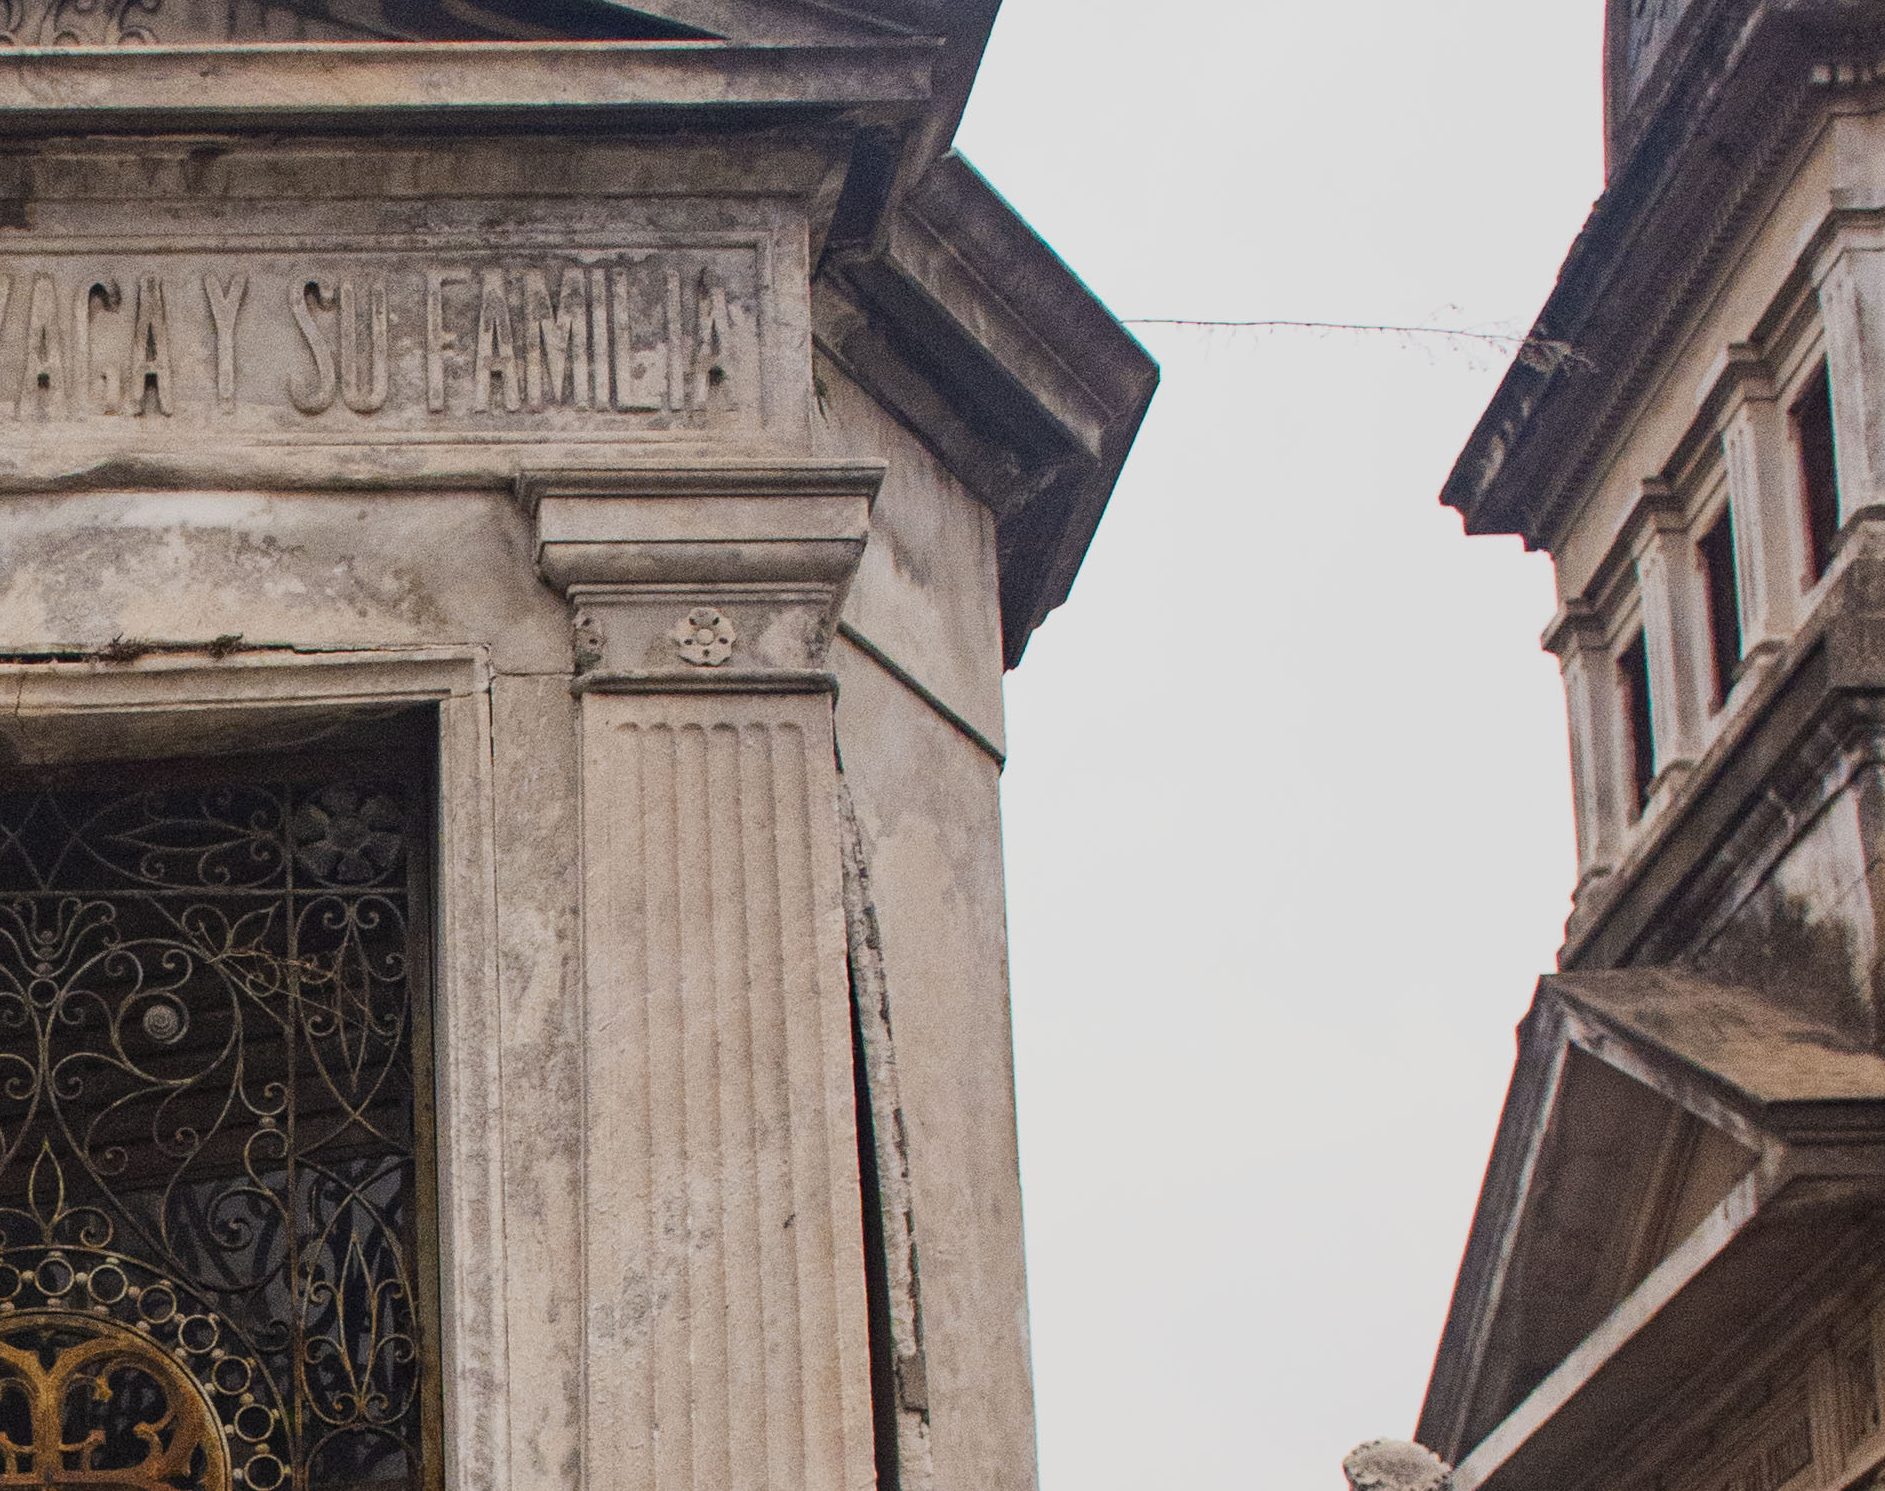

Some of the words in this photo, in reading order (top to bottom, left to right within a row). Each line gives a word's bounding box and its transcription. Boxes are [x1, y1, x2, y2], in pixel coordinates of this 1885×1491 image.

[202, 270, 249, 414] Y
[286, 273, 391, 415] SU
[423, 266, 742, 415] FAMILIA
